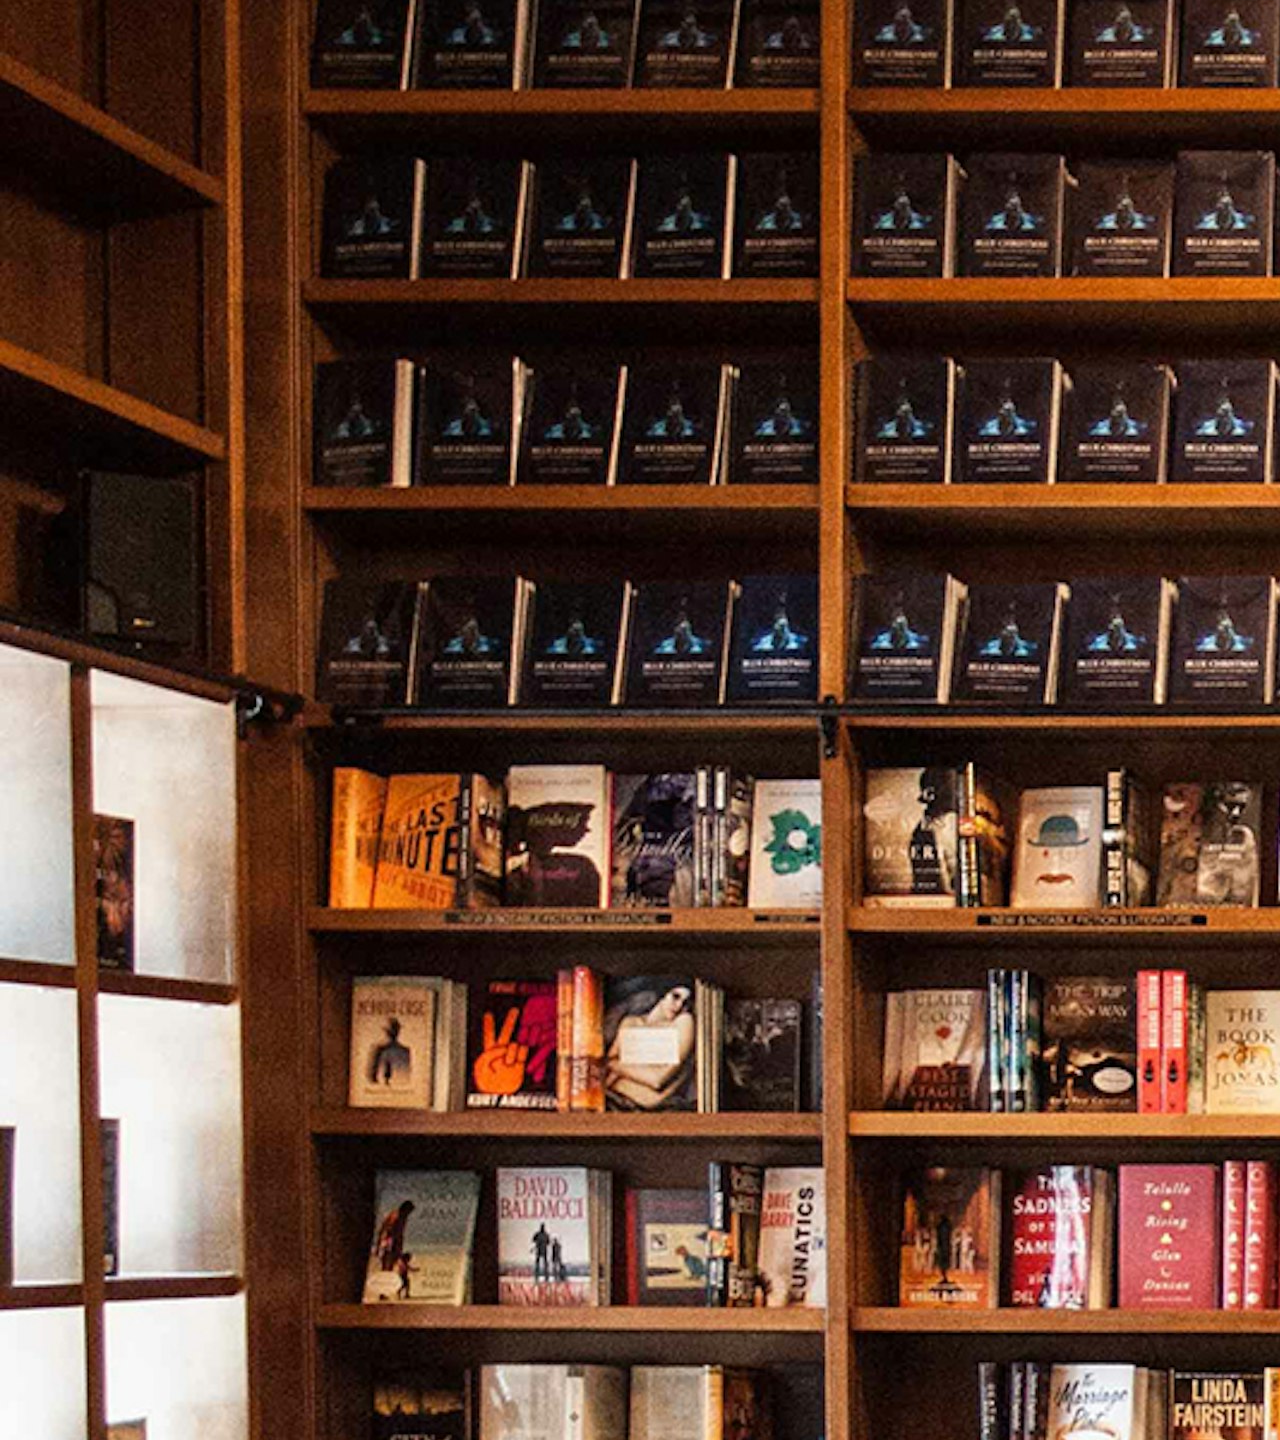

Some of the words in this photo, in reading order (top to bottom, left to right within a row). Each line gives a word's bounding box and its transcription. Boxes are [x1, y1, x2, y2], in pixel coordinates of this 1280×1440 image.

[915, 995, 973, 1006] CLAIRE
[918, 1012, 972, 1025] COOK
[1226, 1007, 1267, 1022] THE
[1217, 1029, 1275, 1044] BOOK
[1213, 1072, 1277, 1088] JONAS
[514, 1176, 568, 1196] DAVID
[500, 1198, 584, 1220] BALDACCI
[764, 1192, 792, 1212] DAVE
[1145, 1215, 1187, 1230] Rising
[792, 1186, 816, 1302] LUNATICS
[1151, 1250, 1181, 1262] Glen
[1144, 1279, 1191, 1292] Duncan
[1192, 1379, 1247, 1403] LINDA
[1174, 1403, 1263, 1427] FAIRSTEIN
